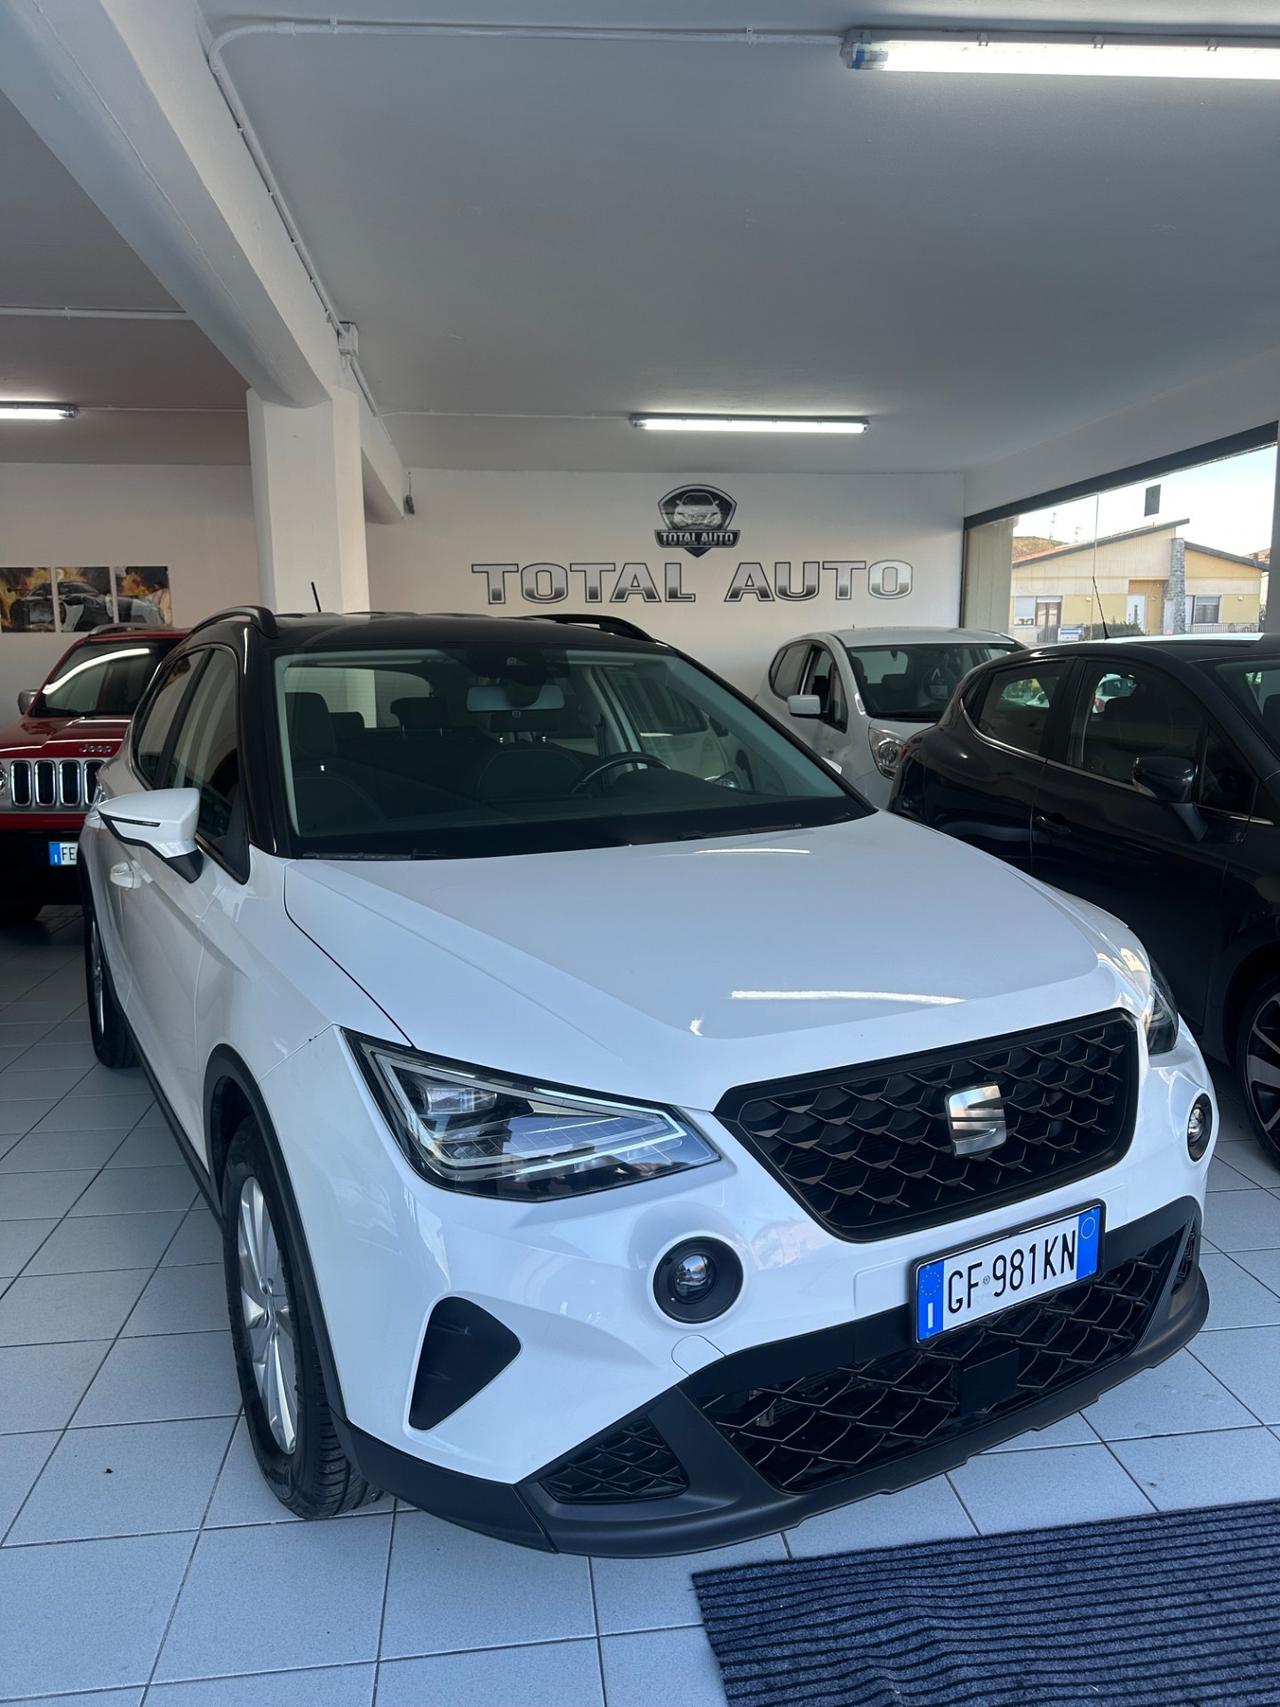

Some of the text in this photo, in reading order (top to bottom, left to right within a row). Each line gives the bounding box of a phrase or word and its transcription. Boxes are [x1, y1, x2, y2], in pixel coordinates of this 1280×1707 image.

[661, 532, 734, 545] TOTAL AUTO
[471, 559, 914, 604] TOTAL AUTO
[61, 847, 77, 861] FE
[948, 1262, 983, 1314] GF
[992, 1230, 1076, 1297] 981KN
